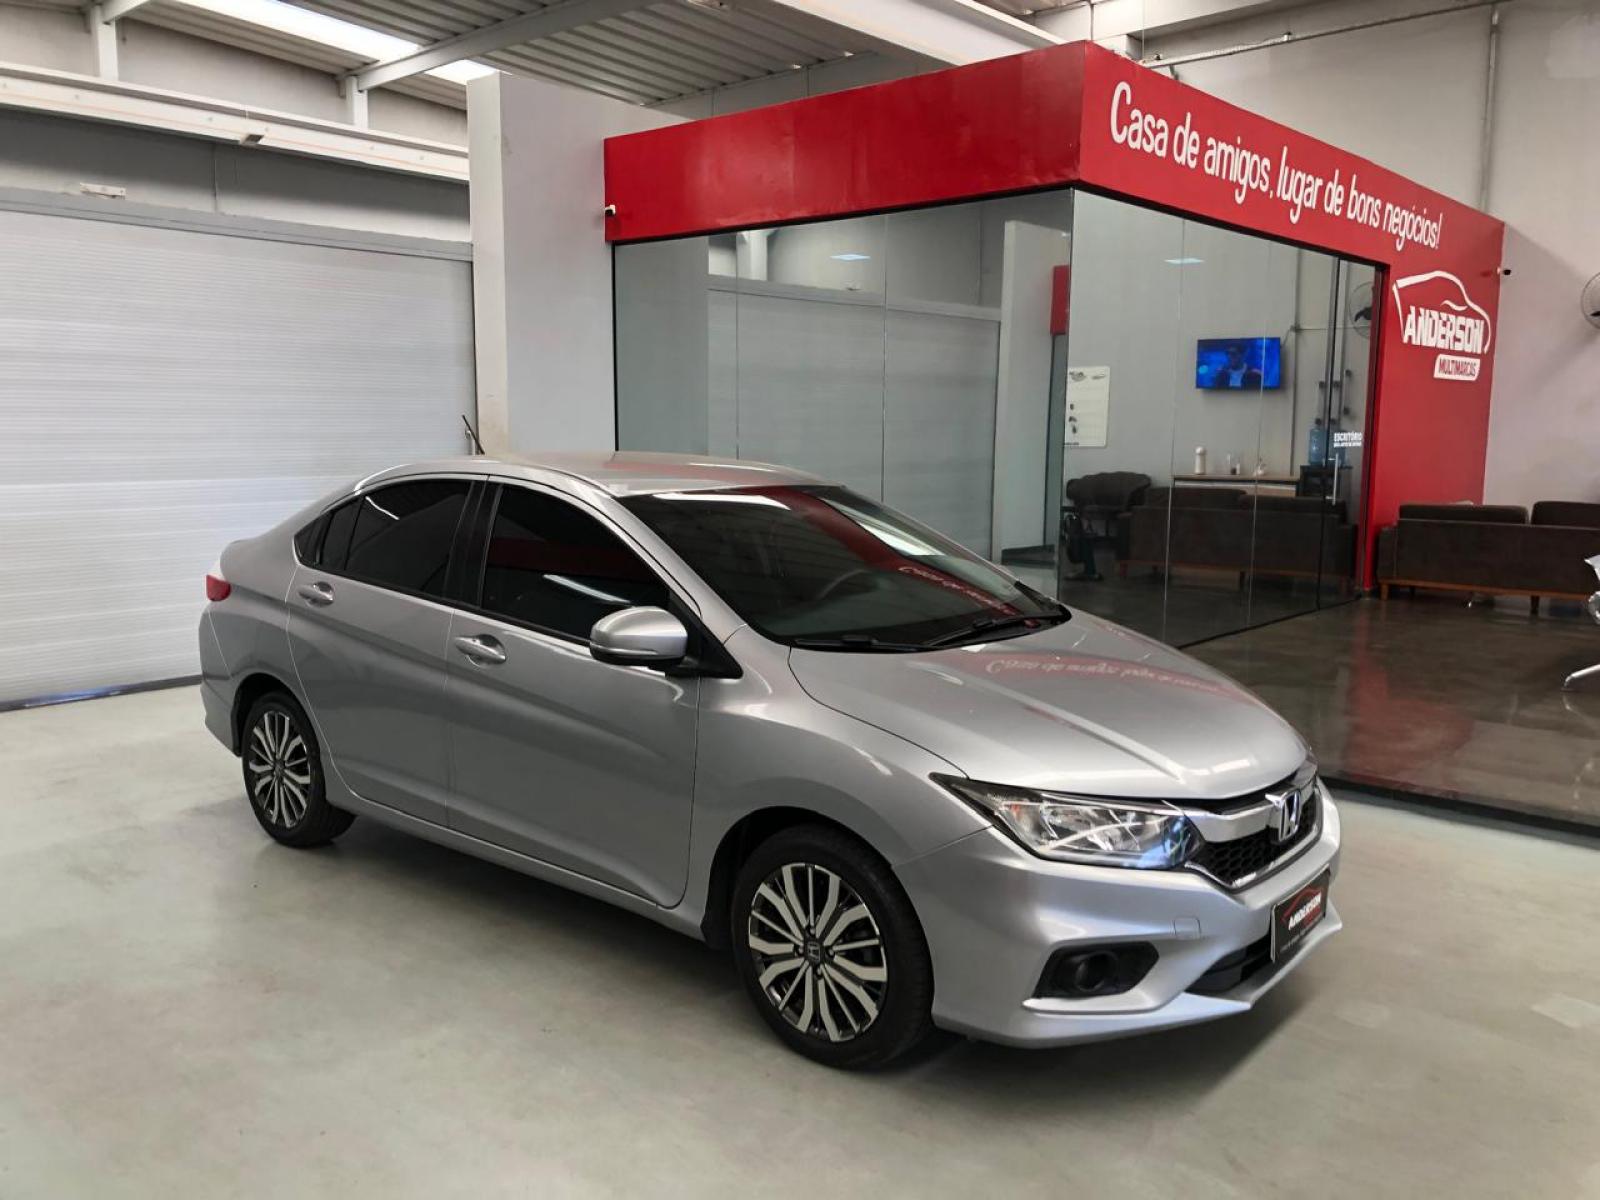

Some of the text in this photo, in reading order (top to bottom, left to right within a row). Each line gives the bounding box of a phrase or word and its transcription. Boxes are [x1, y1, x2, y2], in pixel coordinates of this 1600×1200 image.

[1110, 81, 1442, 251] Casa de amigos, lugar de bons negócios!
[1403, 305, 1484, 354] ANDERSON
[1438, 357, 1477, 377] MULTIMARCAS
